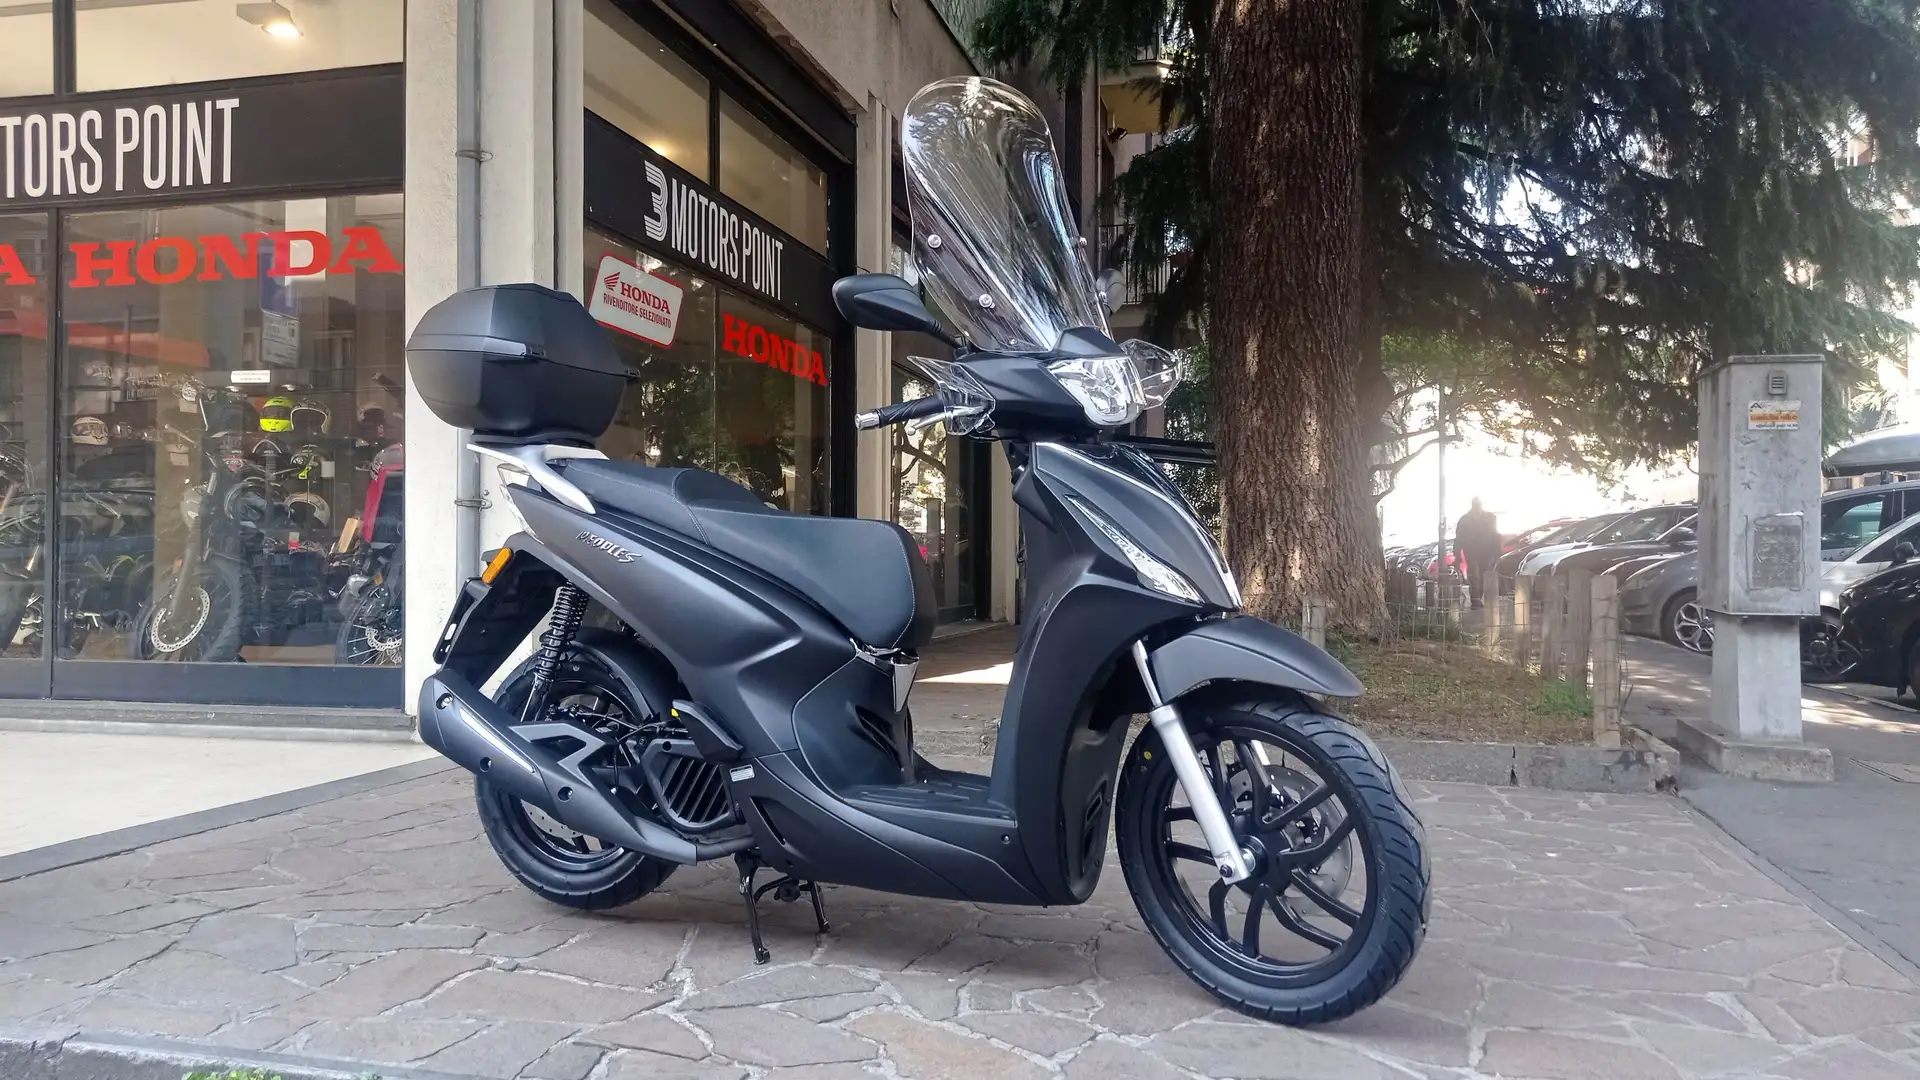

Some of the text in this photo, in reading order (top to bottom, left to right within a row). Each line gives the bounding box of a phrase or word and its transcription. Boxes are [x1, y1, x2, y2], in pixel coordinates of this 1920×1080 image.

[0, 98, 240, 198] TORS POINT
[69, 226, 403, 288] HONDA
[671, 178, 739, 280] MOTORS
[742, 220, 783, 300] POINT
[603, 293, 672, 329] RIVENDITORE SELEZIONATO
[620, 281, 671, 315] HONDA
[722, 312, 828, 387] HONDA
